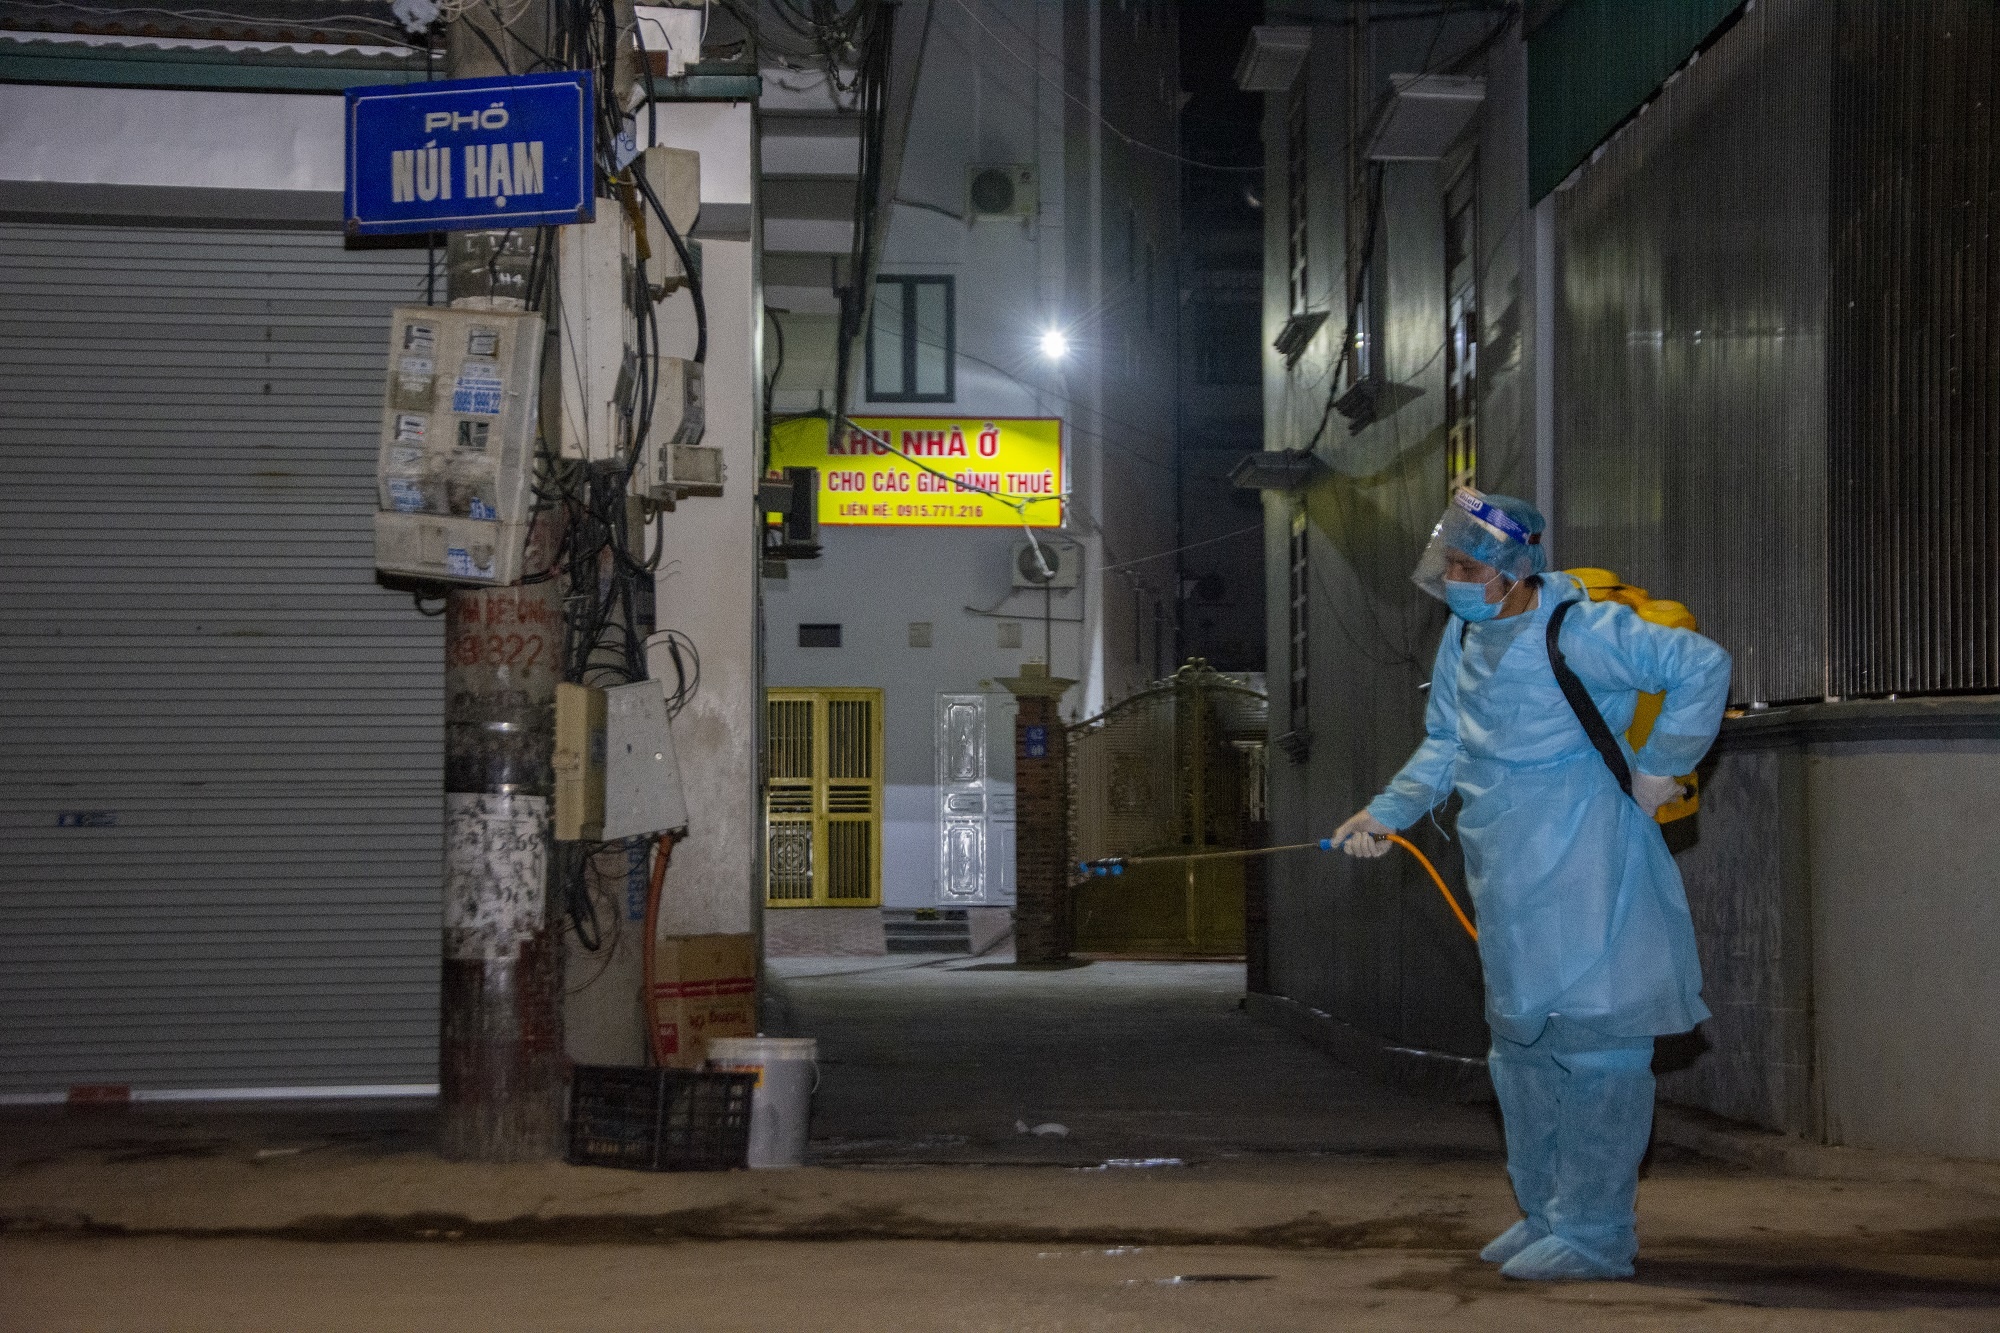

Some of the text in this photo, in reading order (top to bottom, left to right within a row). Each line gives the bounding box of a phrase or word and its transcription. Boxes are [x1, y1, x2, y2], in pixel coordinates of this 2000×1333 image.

[425, 102, 509, 132] PHỐ
[392, 139, 544, 207] NÚI HẠM
[903, 426, 968, 457] NHÀ
[979, 422, 1000, 457] Ở
[828, 472, 865, 492] CHO
[873, 468, 910, 492] CÁC
[917, 472, 948, 493] GIA
[1007, 470, 1053, 493] THUÊ
[839, 502, 868, 517] LIÊN
[897, 505, 983, 517] 0915.771.216
